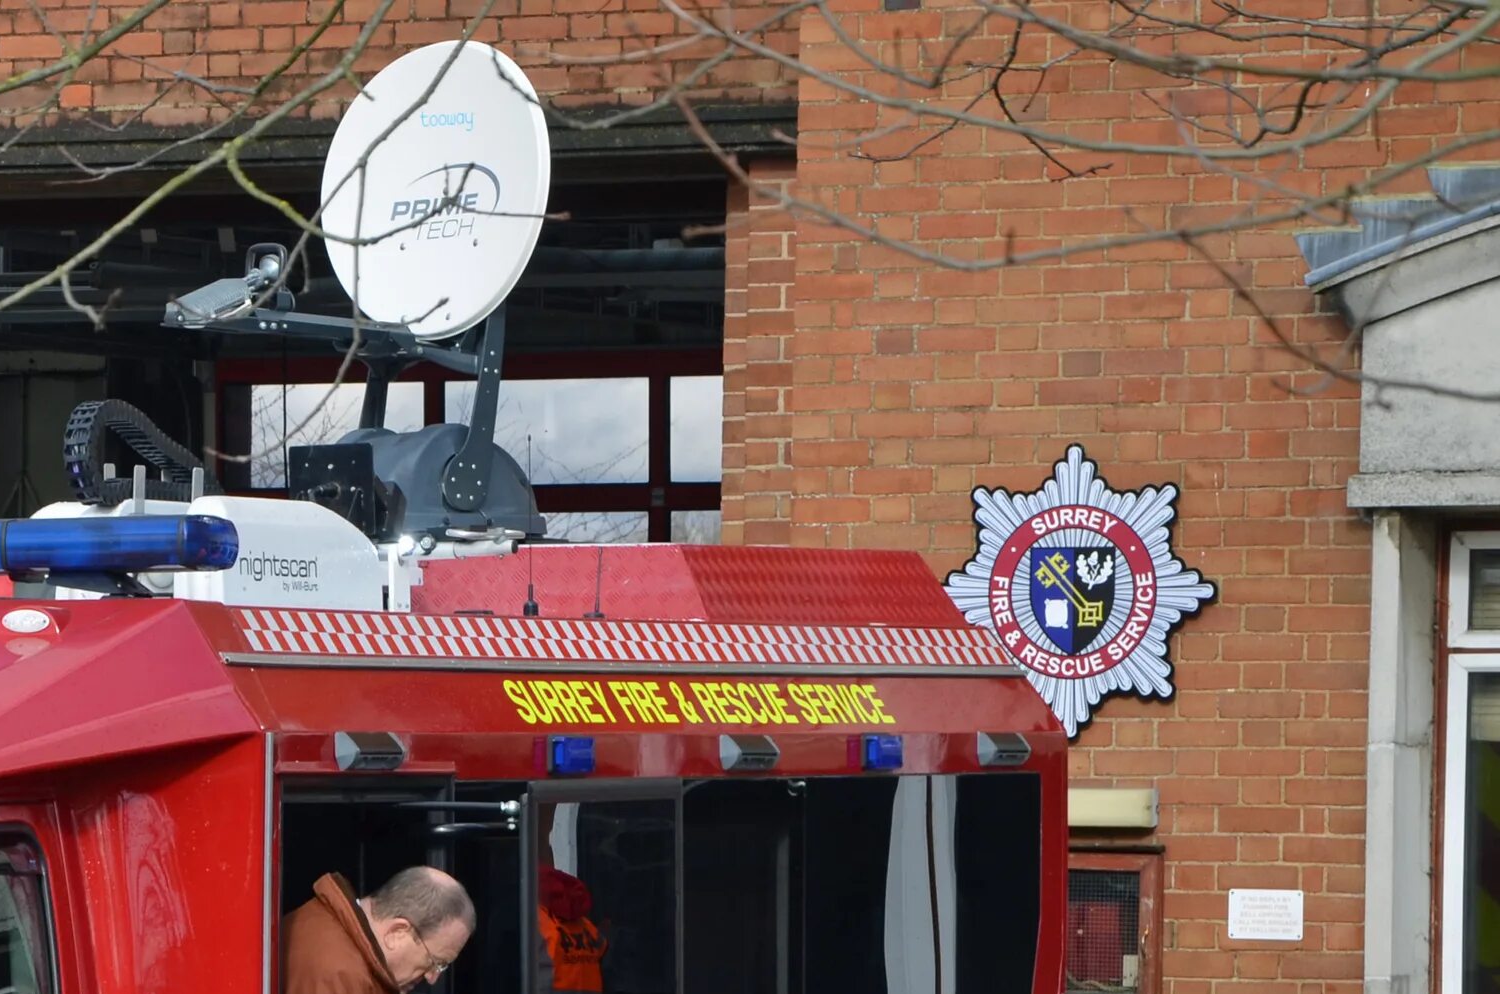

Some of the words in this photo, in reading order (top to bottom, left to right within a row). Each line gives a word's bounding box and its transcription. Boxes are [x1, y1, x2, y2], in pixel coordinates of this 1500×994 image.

[420, 112, 474, 131] tooway
[390, 193, 479, 221] PRIME
[417, 217, 475, 240] TECH
[1031, 508, 1117, 535] SURREY
[239, 550, 318, 582] nightscan
[992, 575, 1013, 627] FIRE
[1005, 629, 1021, 648] &
[1020, 643, 1105, 676] RESCUE
[1107, 571, 1153, 660] SERVICE
[502, 679, 617, 725] SURREY
[607, 680, 681, 725] FIRE
[672, 680, 704, 725] &
[689, 681, 800, 725] RESCUE
[787, 683, 897, 725] SERVICE
